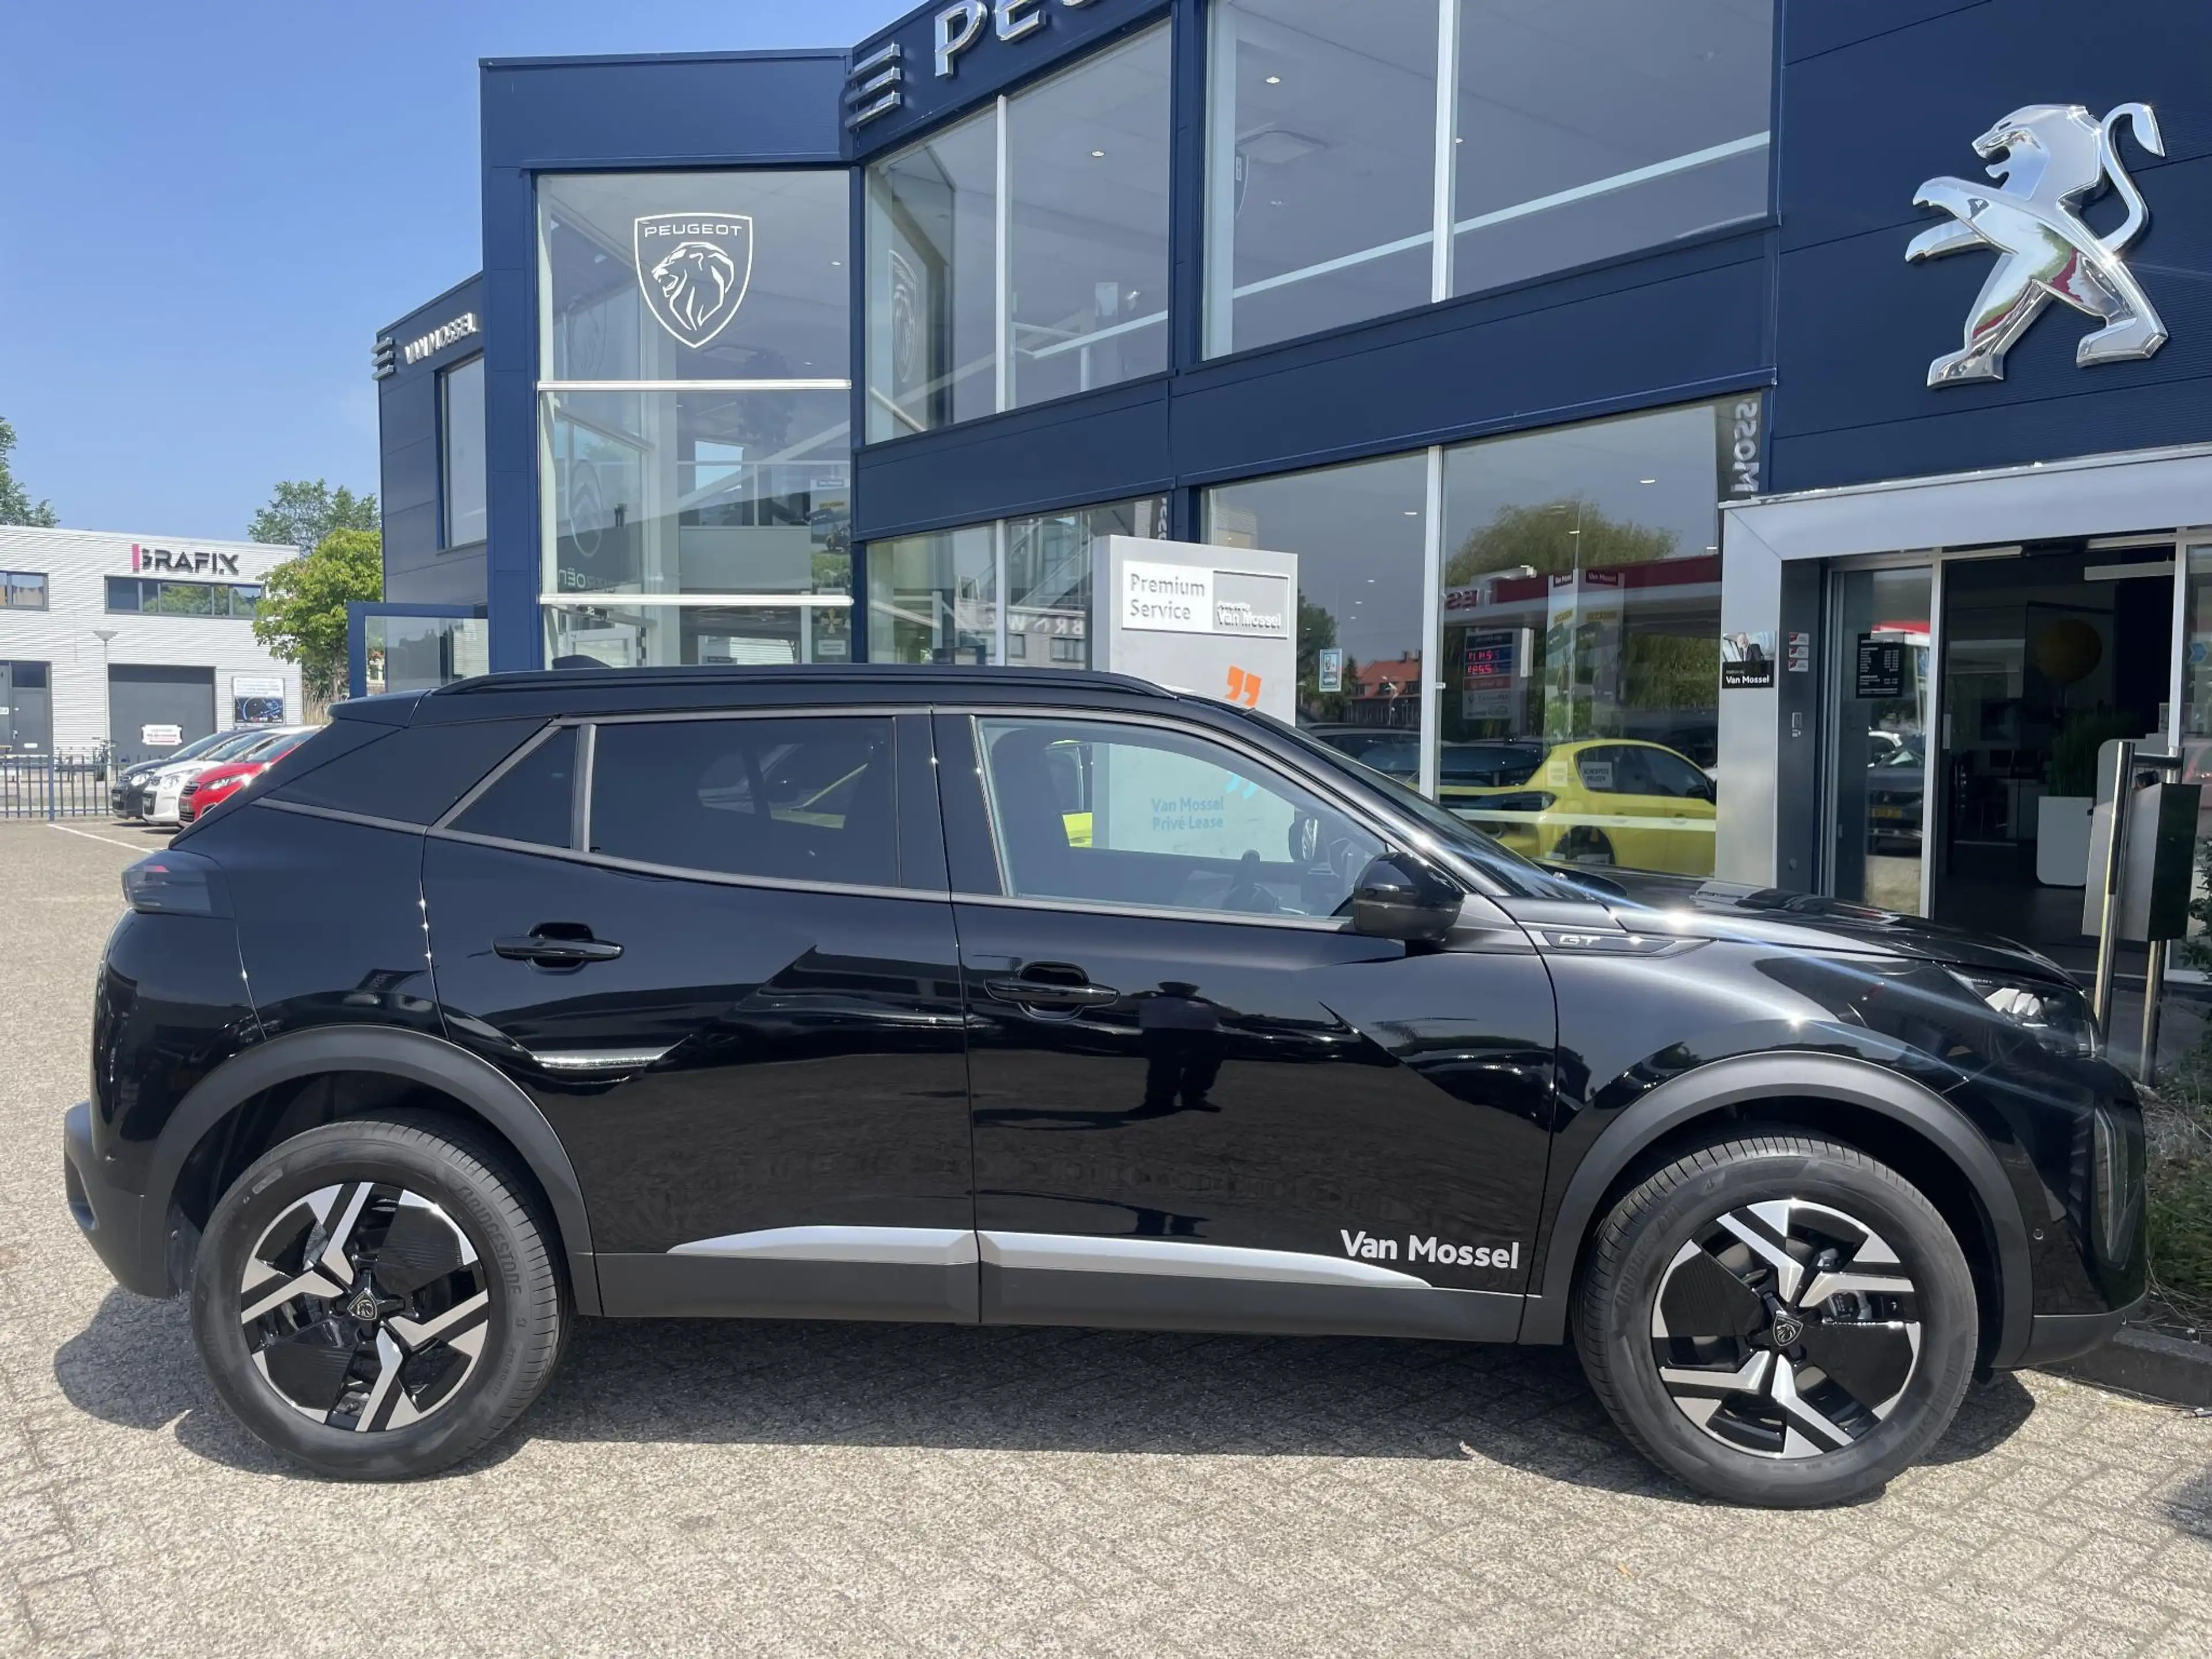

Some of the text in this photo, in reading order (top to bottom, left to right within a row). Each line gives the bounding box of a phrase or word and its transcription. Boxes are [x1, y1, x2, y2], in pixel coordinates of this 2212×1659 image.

[934, 0, 1094, 78] PE
[645, 224, 742, 237] PEUGEOT
[429, 312, 478, 351] MOSSEL
[1130, 573, 1205, 597] Premium
[1130, 599, 1191, 620] Service
[1217, 609, 1282, 629] Van Mossel
[1726, 674, 1769, 684] Van Mossel
[1151, 796, 1224, 812] Van Mossel
[1153, 815, 1224, 831] Privé Lease
[1558, 934, 1601, 946] GT
[459, 1185, 522, 1295] BRIDGESTONE
[1340, 1229, 1520, 1269] Van Mossel
